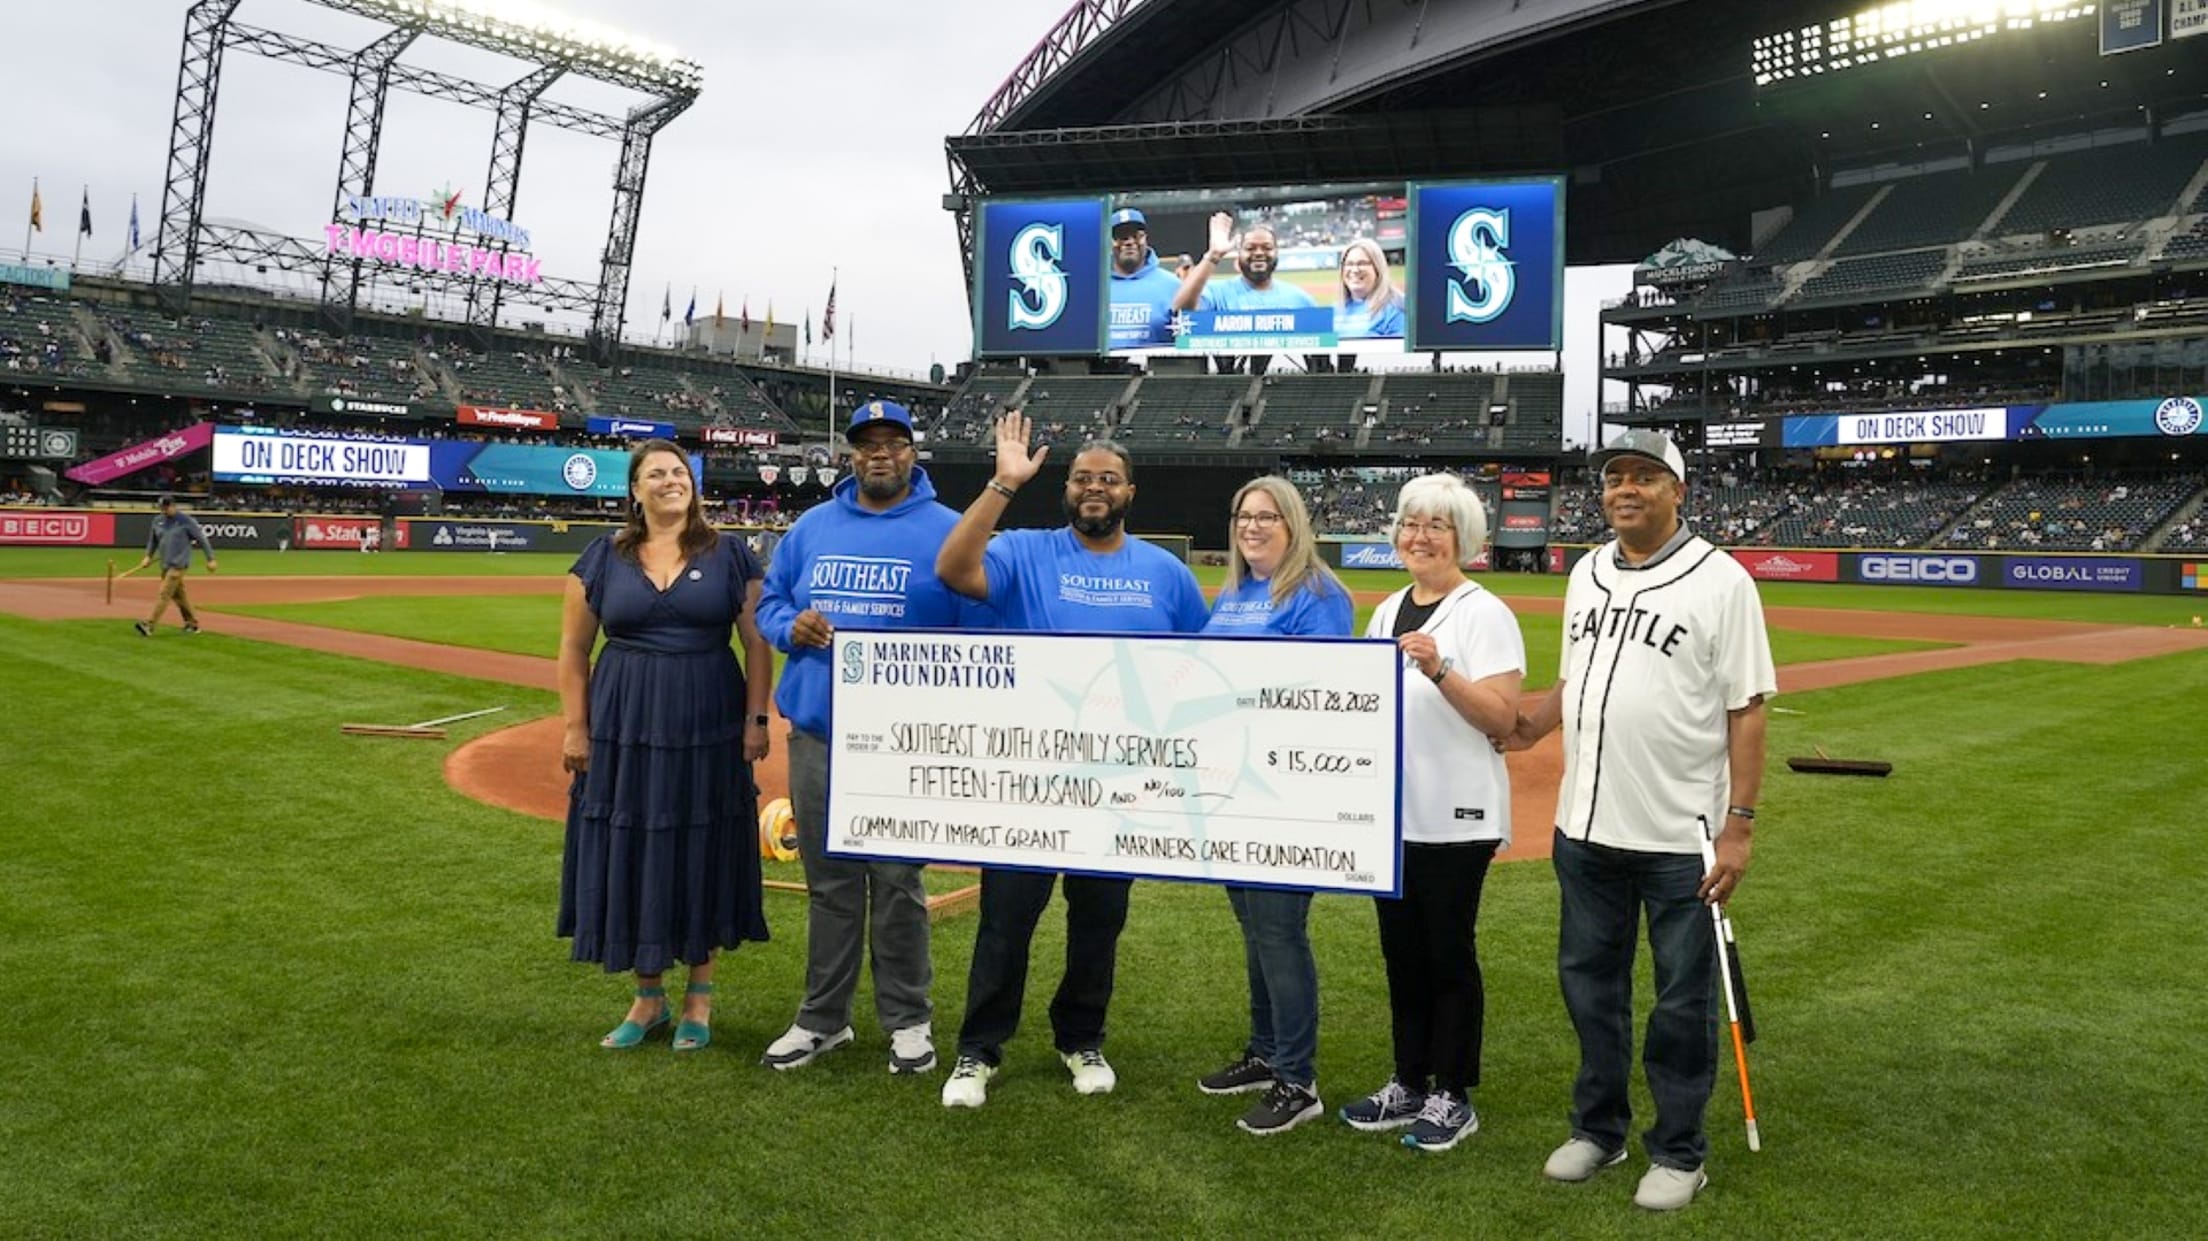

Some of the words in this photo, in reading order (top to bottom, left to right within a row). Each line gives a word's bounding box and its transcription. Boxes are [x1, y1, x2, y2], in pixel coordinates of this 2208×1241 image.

[324, 223, 466, 272] T-MOBILE
[469, 247, 542, 284] PARK
[1213, 315, 1253, 332] AARON
[1255, 314, 1295, 331] RUFFIN
[347, 401, 408, 415] STARBUCKS
[1857, 418, 1880, 440] ON
[1885, 415, 1934, 439] DECK
[1936, 413, 1986, 437] SHOW
[241, 440, 272, 469] ON
[281, 443, 336, 473] DECK
[343, 446, 407, 475] SHOW
[4, 519, 81, 535] BECU
[809, 561, 912, 593] SOUTHEAST
[1861, 557, 1976, 581] GEICO
[2012, 565, 2092, 581] GLOBAL
[2096, 567, 2131, 575] CREDIT
[1061, 573, 1151, 592] SOUTHEAST
[873, 642, 963, 663] MARINERS
[969, 644, 1016, 665] CARE
[873, 663, 1016, 689] FOUNDATION
[1236, 697, 1256, 708] DATE
[1259, 687, 1322, 711] AUGUST
[1346, 691, 1380, 713] 2023
[846, 733, 859, 742] PAY
[861, 734, 870, 742] TO
[872, 734, 884, 743] THE
[846, 741, 869, 751] ORDER
[870, 742, 879, 751] OF
[889, 721, 978, 758] SOUTHEAST
[983, 726, 1032, 759] YOUTH
[1038, 728, 1050, 760] &
[1054, 729, 1110, 763] FAMILY
[1115, 734, 1199, 768] SERVICES
[1267, 750, 1278, 766] $
[909, 765, 1104, 808] FIFTEEN-THOUSAND
[1110, 791, 1137, 805] AND
[1337, 811, 1375, 823] DOLLARS
[843, 839, 864, 848] MEMO
[850, 815, 940, 843] COMMUNITY
[945, 824, 1003, 847] IMPACT
[1005, 827, 1072, 851] GRANT
[1114, 834, 1197, 861] MARINERS
[1201, 839, 1241, 864] CARE
[1246, 841, 1357, 873] FOUNDATION
[1345, 873, 1376, 884] SIGNED
